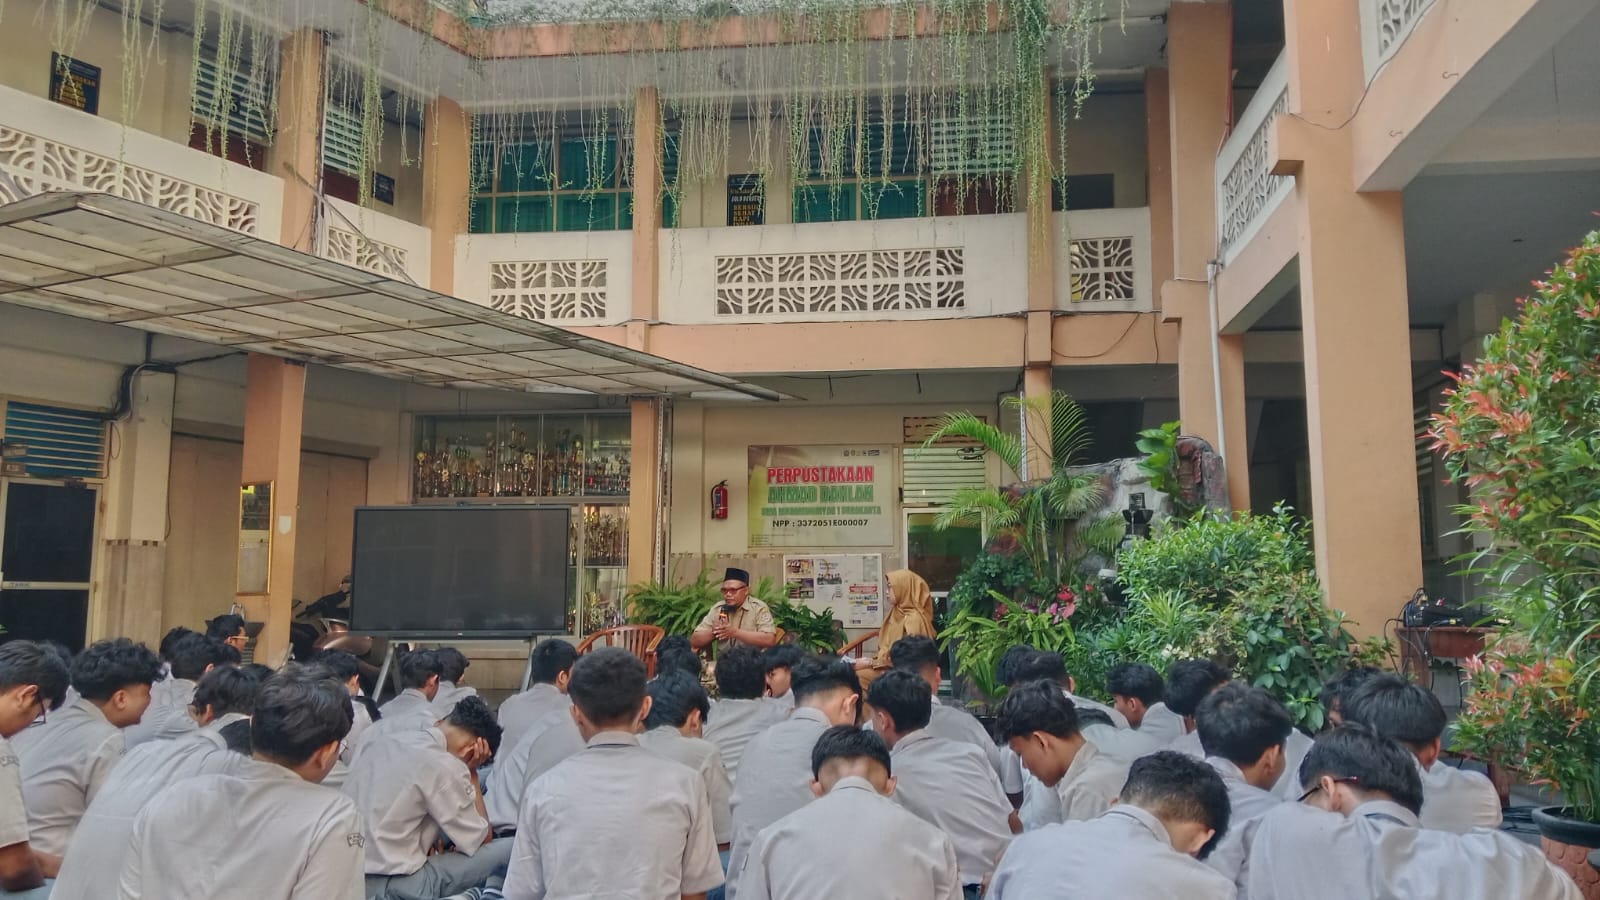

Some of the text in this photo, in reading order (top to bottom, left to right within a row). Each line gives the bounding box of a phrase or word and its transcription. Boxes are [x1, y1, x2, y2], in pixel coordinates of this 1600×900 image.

[767, 466, 875, 483] PERPUSTAKAAN
[772, 520, 790, 528] NPP
[797, 519, 869, 527] 3372051E000007
